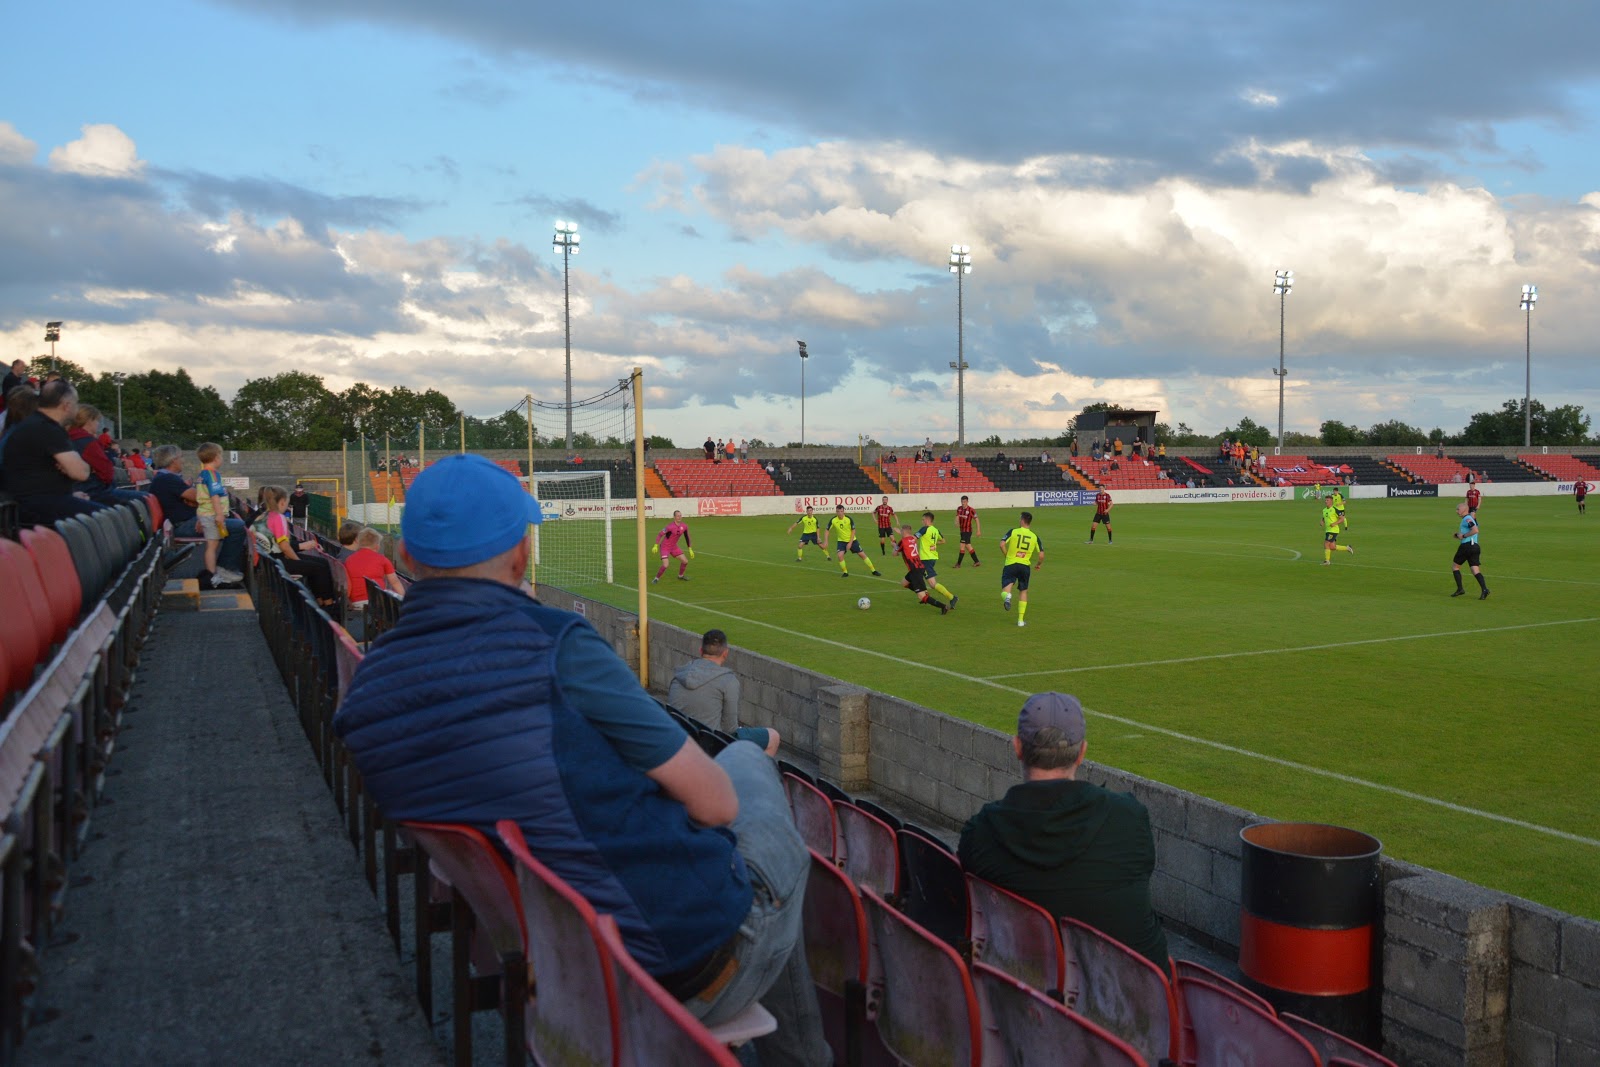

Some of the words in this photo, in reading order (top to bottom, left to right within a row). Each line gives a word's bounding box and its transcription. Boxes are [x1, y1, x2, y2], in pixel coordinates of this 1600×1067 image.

[1035, 491, 1079, 502] HOROHOE
[1231, 490, 1277, 500] providers.ie
[1390, 487, 1422, 497] MUNNELLY
[804, 496, 829, 507] RED
[834, 495, 873, 506] DOOR
[1016, 534, 1032, 551] 15
